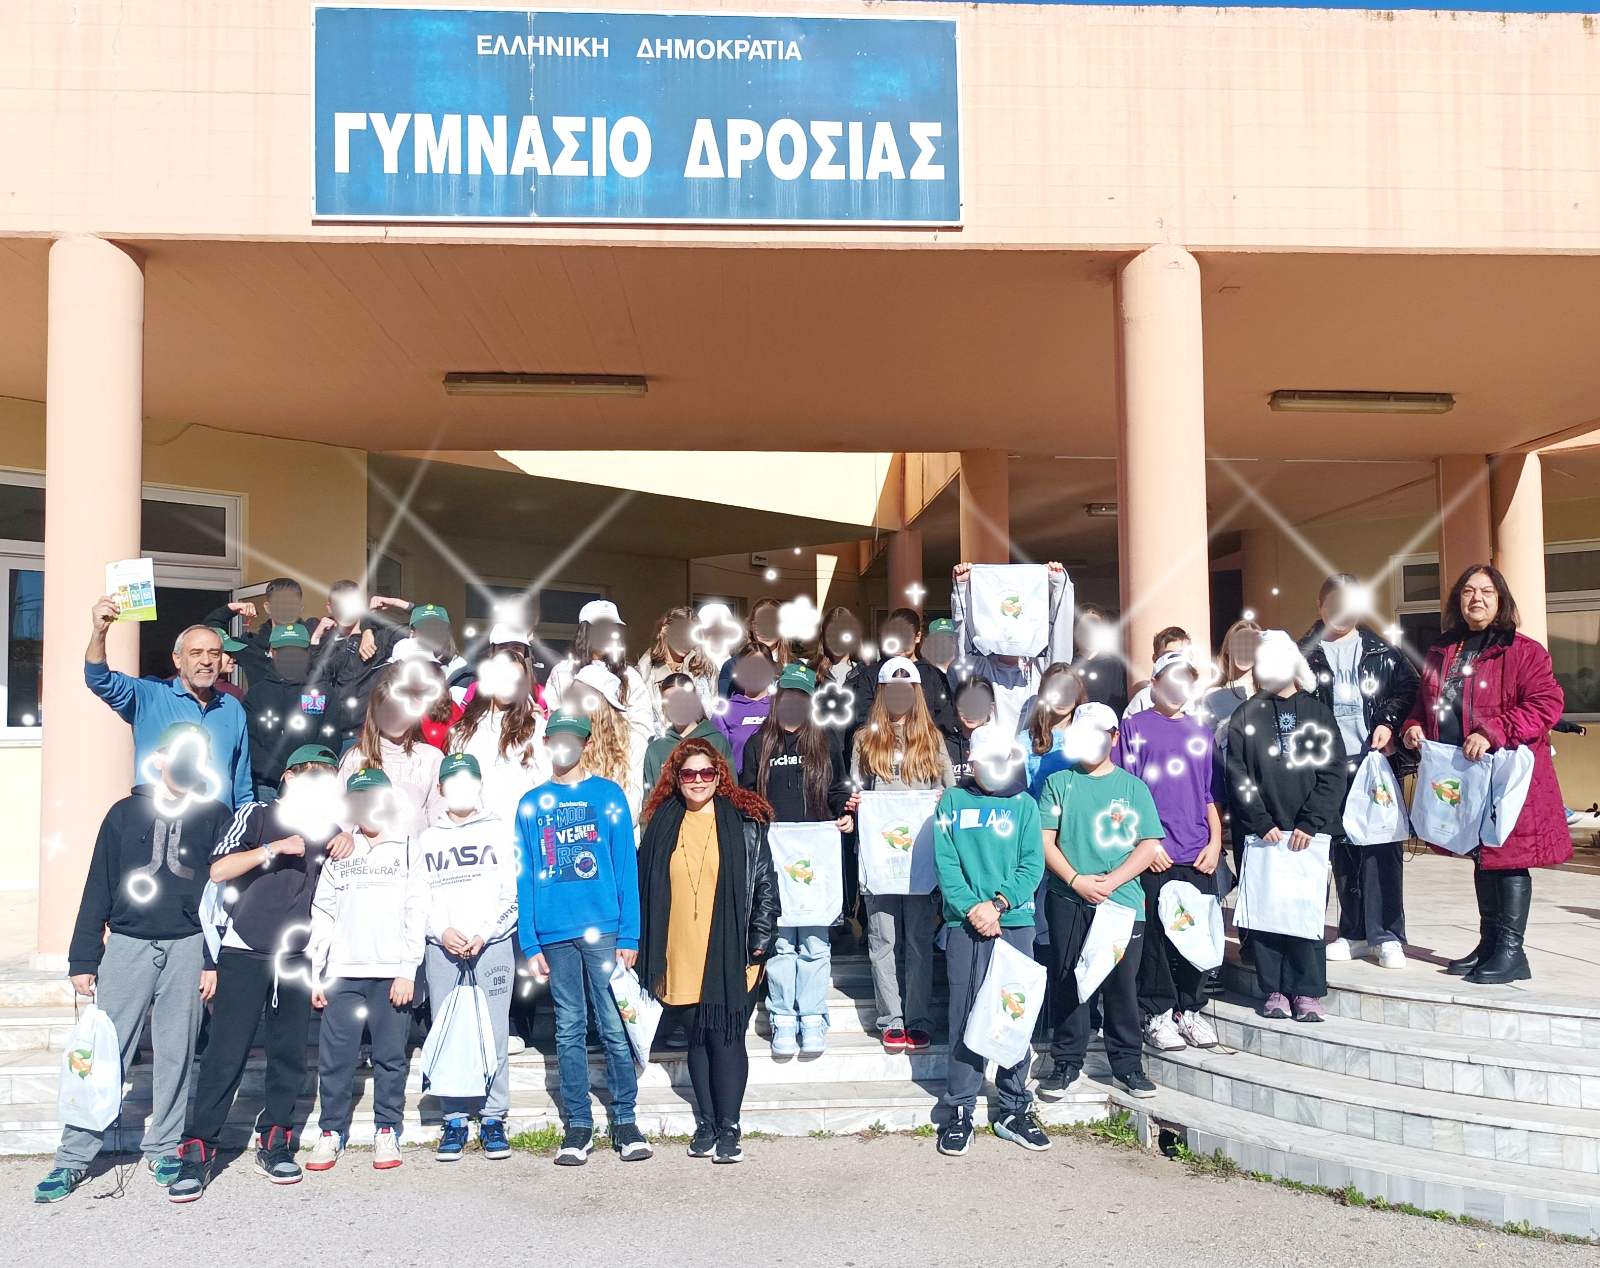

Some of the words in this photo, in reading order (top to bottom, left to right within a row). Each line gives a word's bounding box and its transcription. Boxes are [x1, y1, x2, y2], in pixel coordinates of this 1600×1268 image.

[476, 34, 609, 59] ΕΛΛΗΝΙΚΗ
[636, 37, 802, 61] ΔΗΜΟΚΡΑΤΙΑ
[334, 111, 652, 179] ΓΥΜΝΑΣΙΟ
[683, 118, 945, 182] ΔΡΟΣΙΑΣ
[425, 845, 498, 872] NASA
